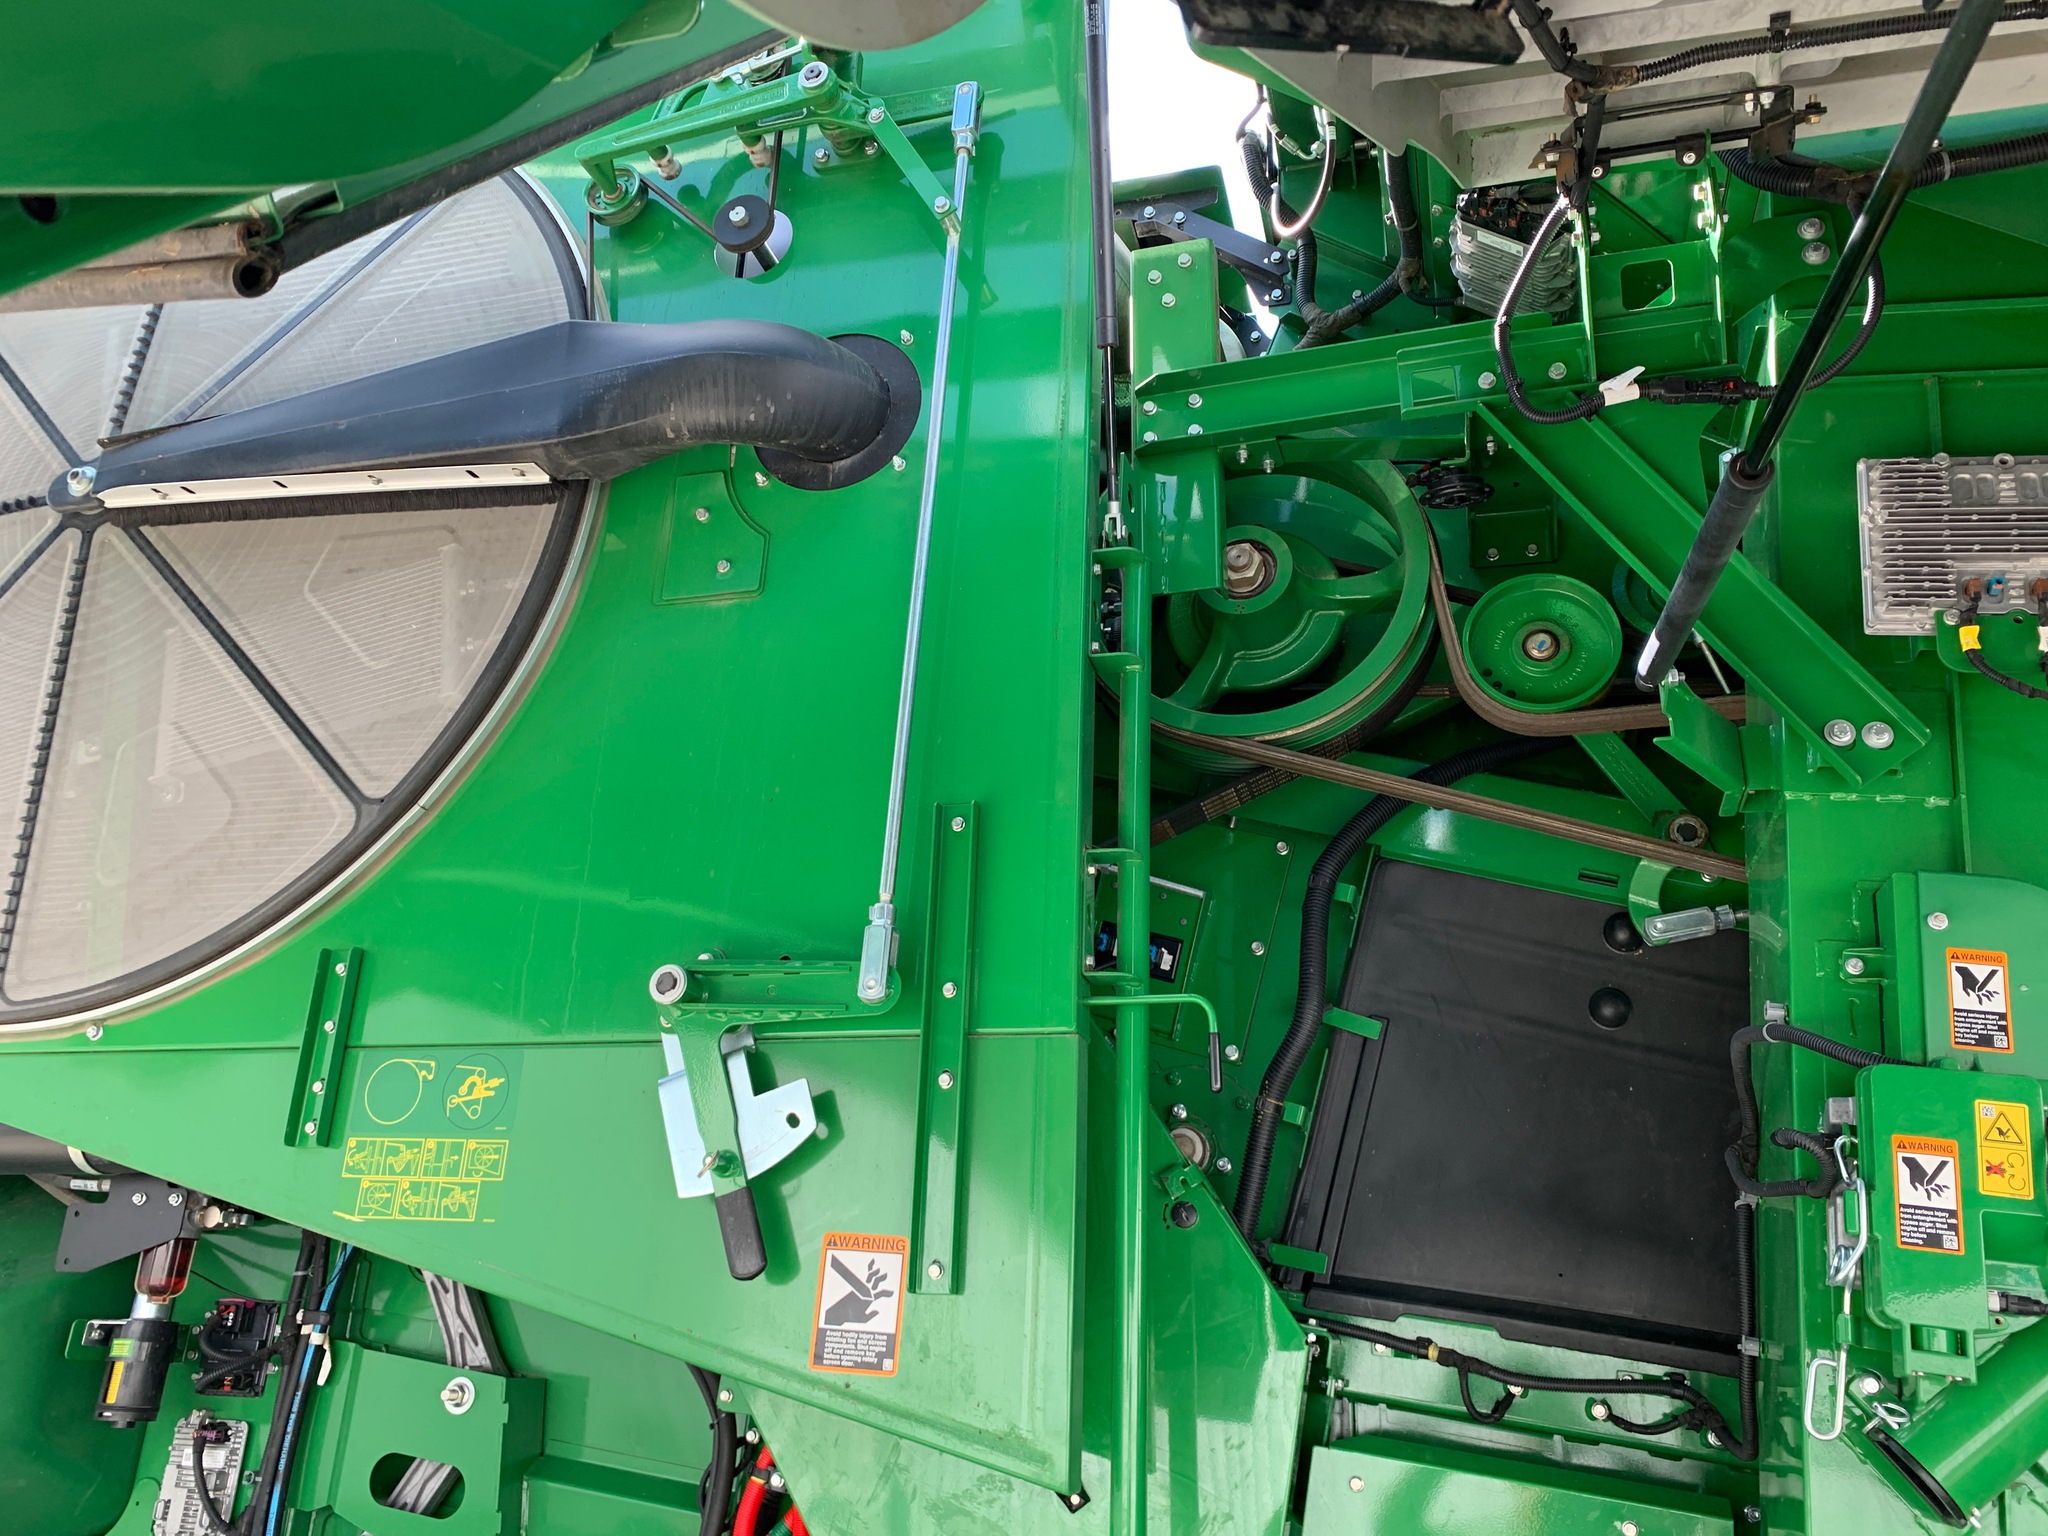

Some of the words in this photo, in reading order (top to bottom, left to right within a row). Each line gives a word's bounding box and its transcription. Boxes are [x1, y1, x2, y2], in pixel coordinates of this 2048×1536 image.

[1961, 953, 2003, 963] WARNING
[1908, 1142, 1953, 1153] WARNING
[839, 1235, 906, 1251] WARNING
[1901, 1237, 1924, 1245] cleaning.
[826, 1336, 846, 1344] rotating
[859, 1332, 874, 1340] injury
[841, 1355, 861, 1363] opening
